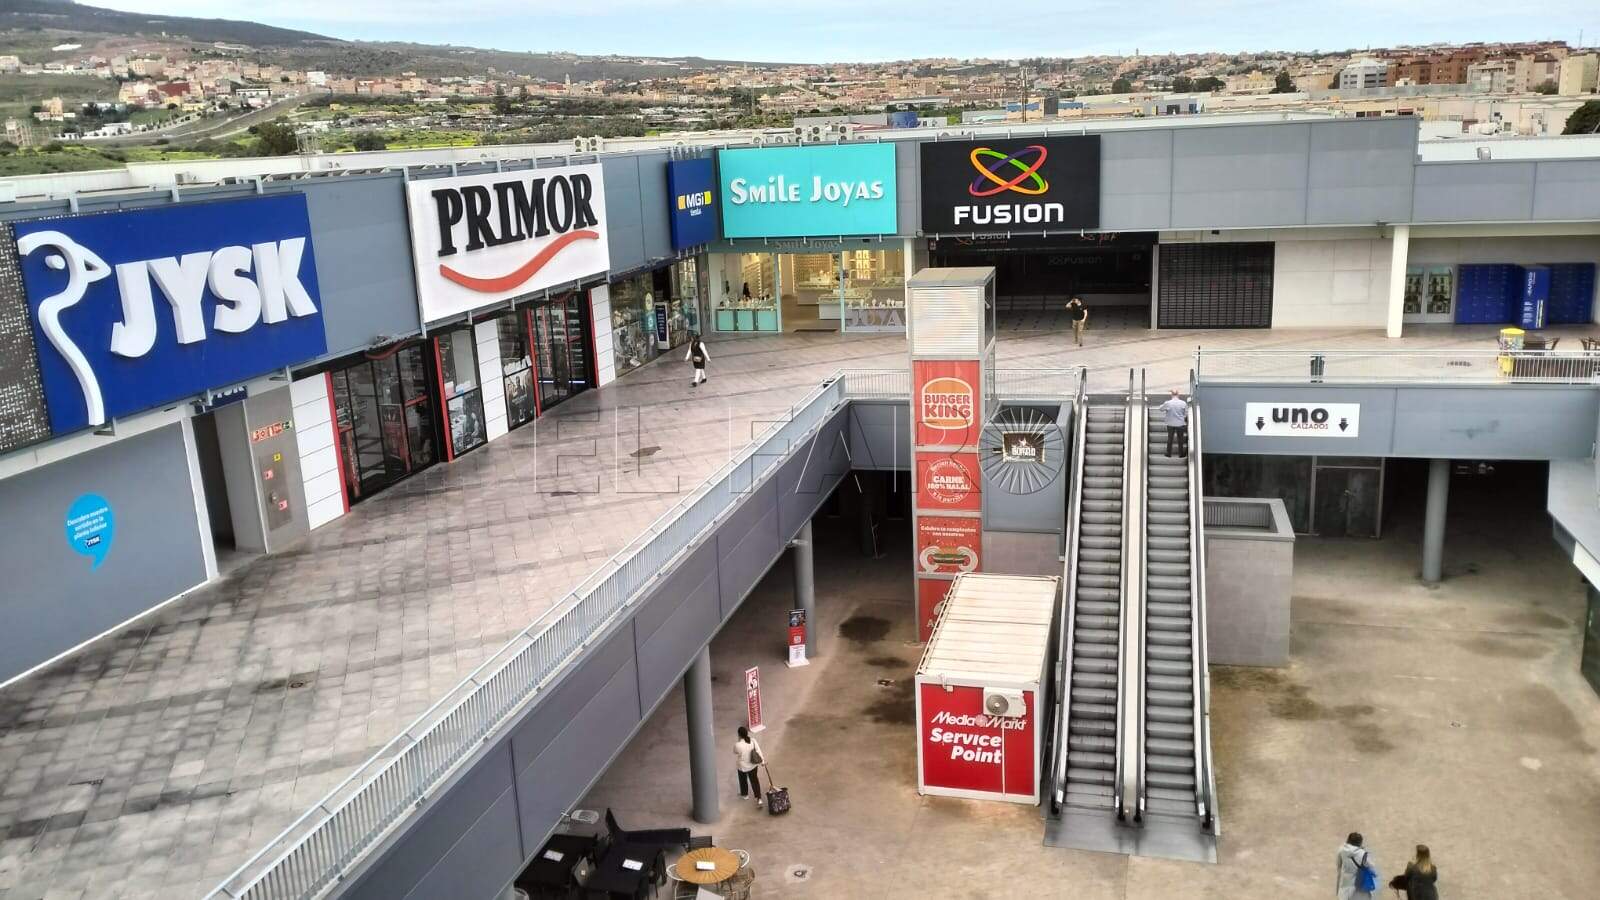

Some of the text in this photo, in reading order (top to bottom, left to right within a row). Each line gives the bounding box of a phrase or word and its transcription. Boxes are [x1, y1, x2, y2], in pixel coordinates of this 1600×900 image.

[432, 173, 598, 257] PRIMOR
[954, 203, 1064, 225] FUSION
[111, 236, 318, 358] JYSK
[924, 394, 970, 404] BURGER
[924, 404, 971, 418] KING
[1272, 407, 1329, 424] uno
[933, 475, 965, 484] CARNE
[930, 728, 1002, 747] Service
[951, 745, 1002, 764] Point
